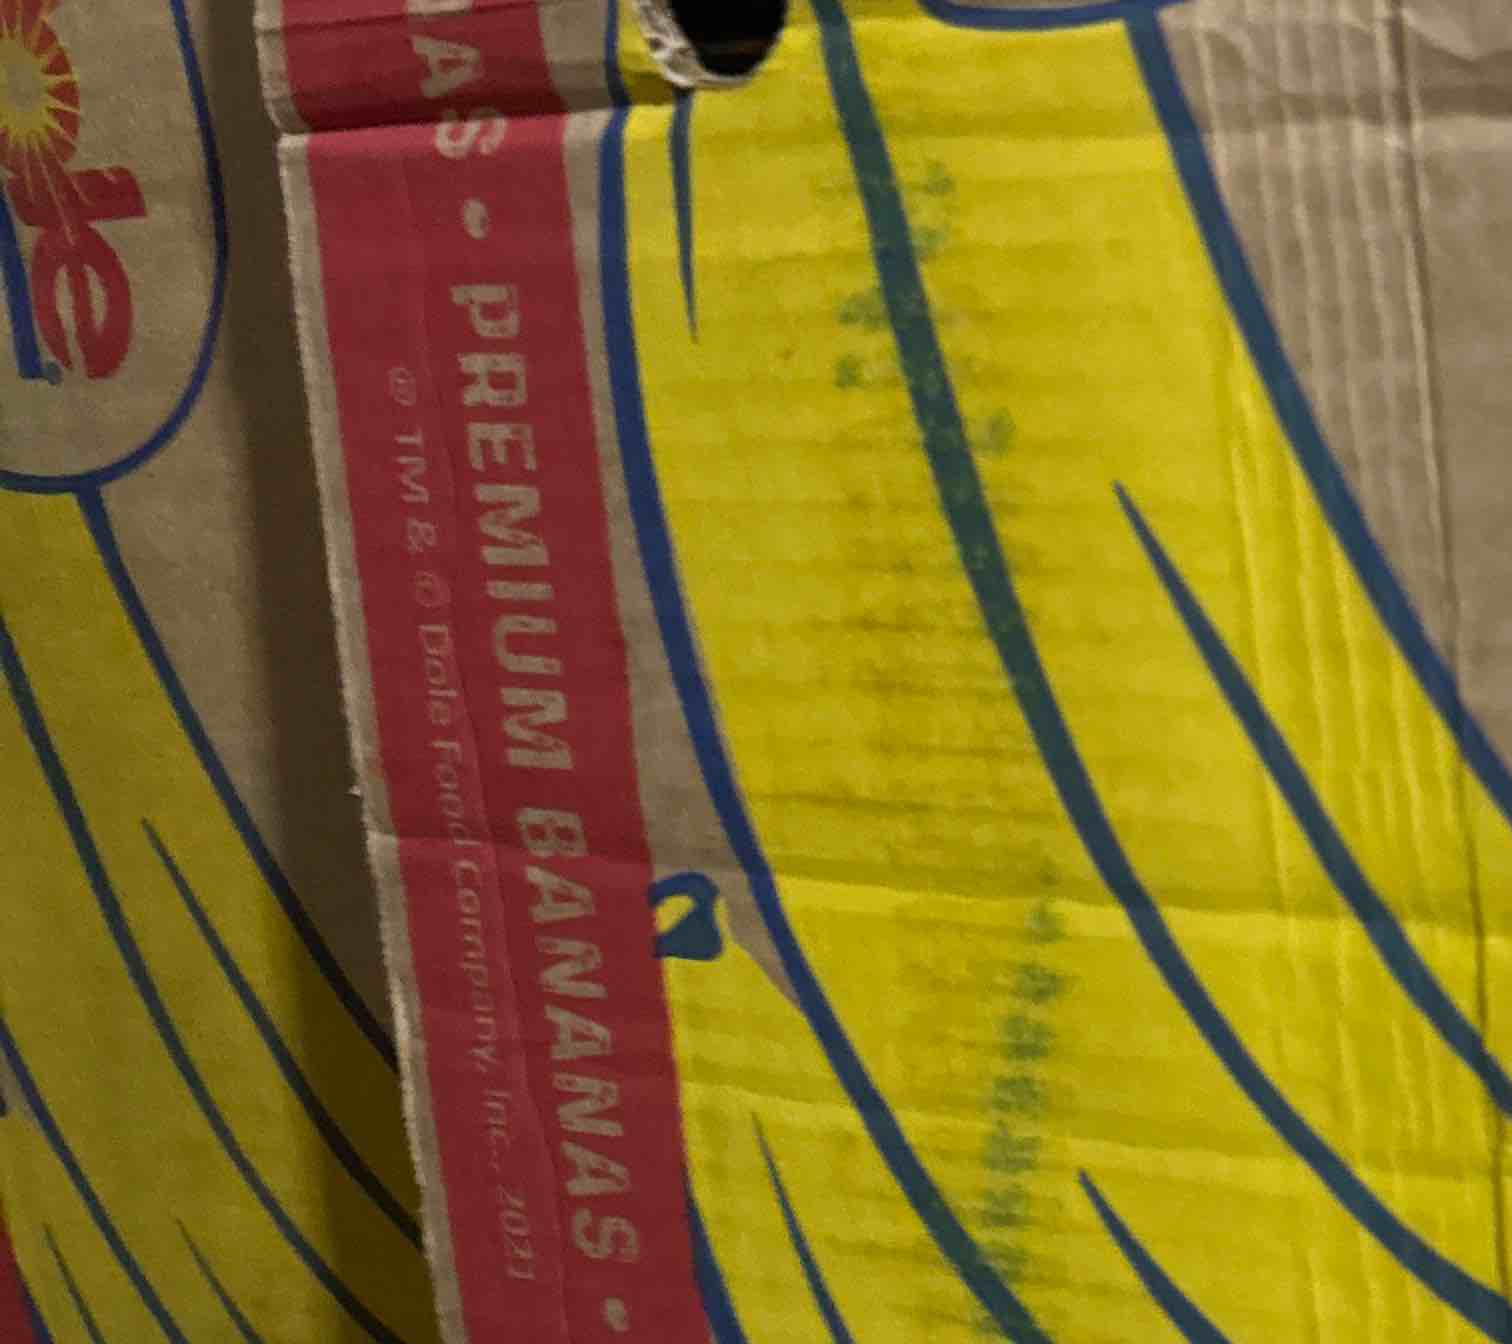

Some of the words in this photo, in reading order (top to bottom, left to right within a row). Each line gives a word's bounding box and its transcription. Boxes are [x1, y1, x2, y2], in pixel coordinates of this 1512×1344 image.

[414, 622, 466, 730] Dole
[427, 735, 474, 849] Food
[450, 281, 573, 773] PREMIUM
[515, 806, 641, 1266] BANANAS
